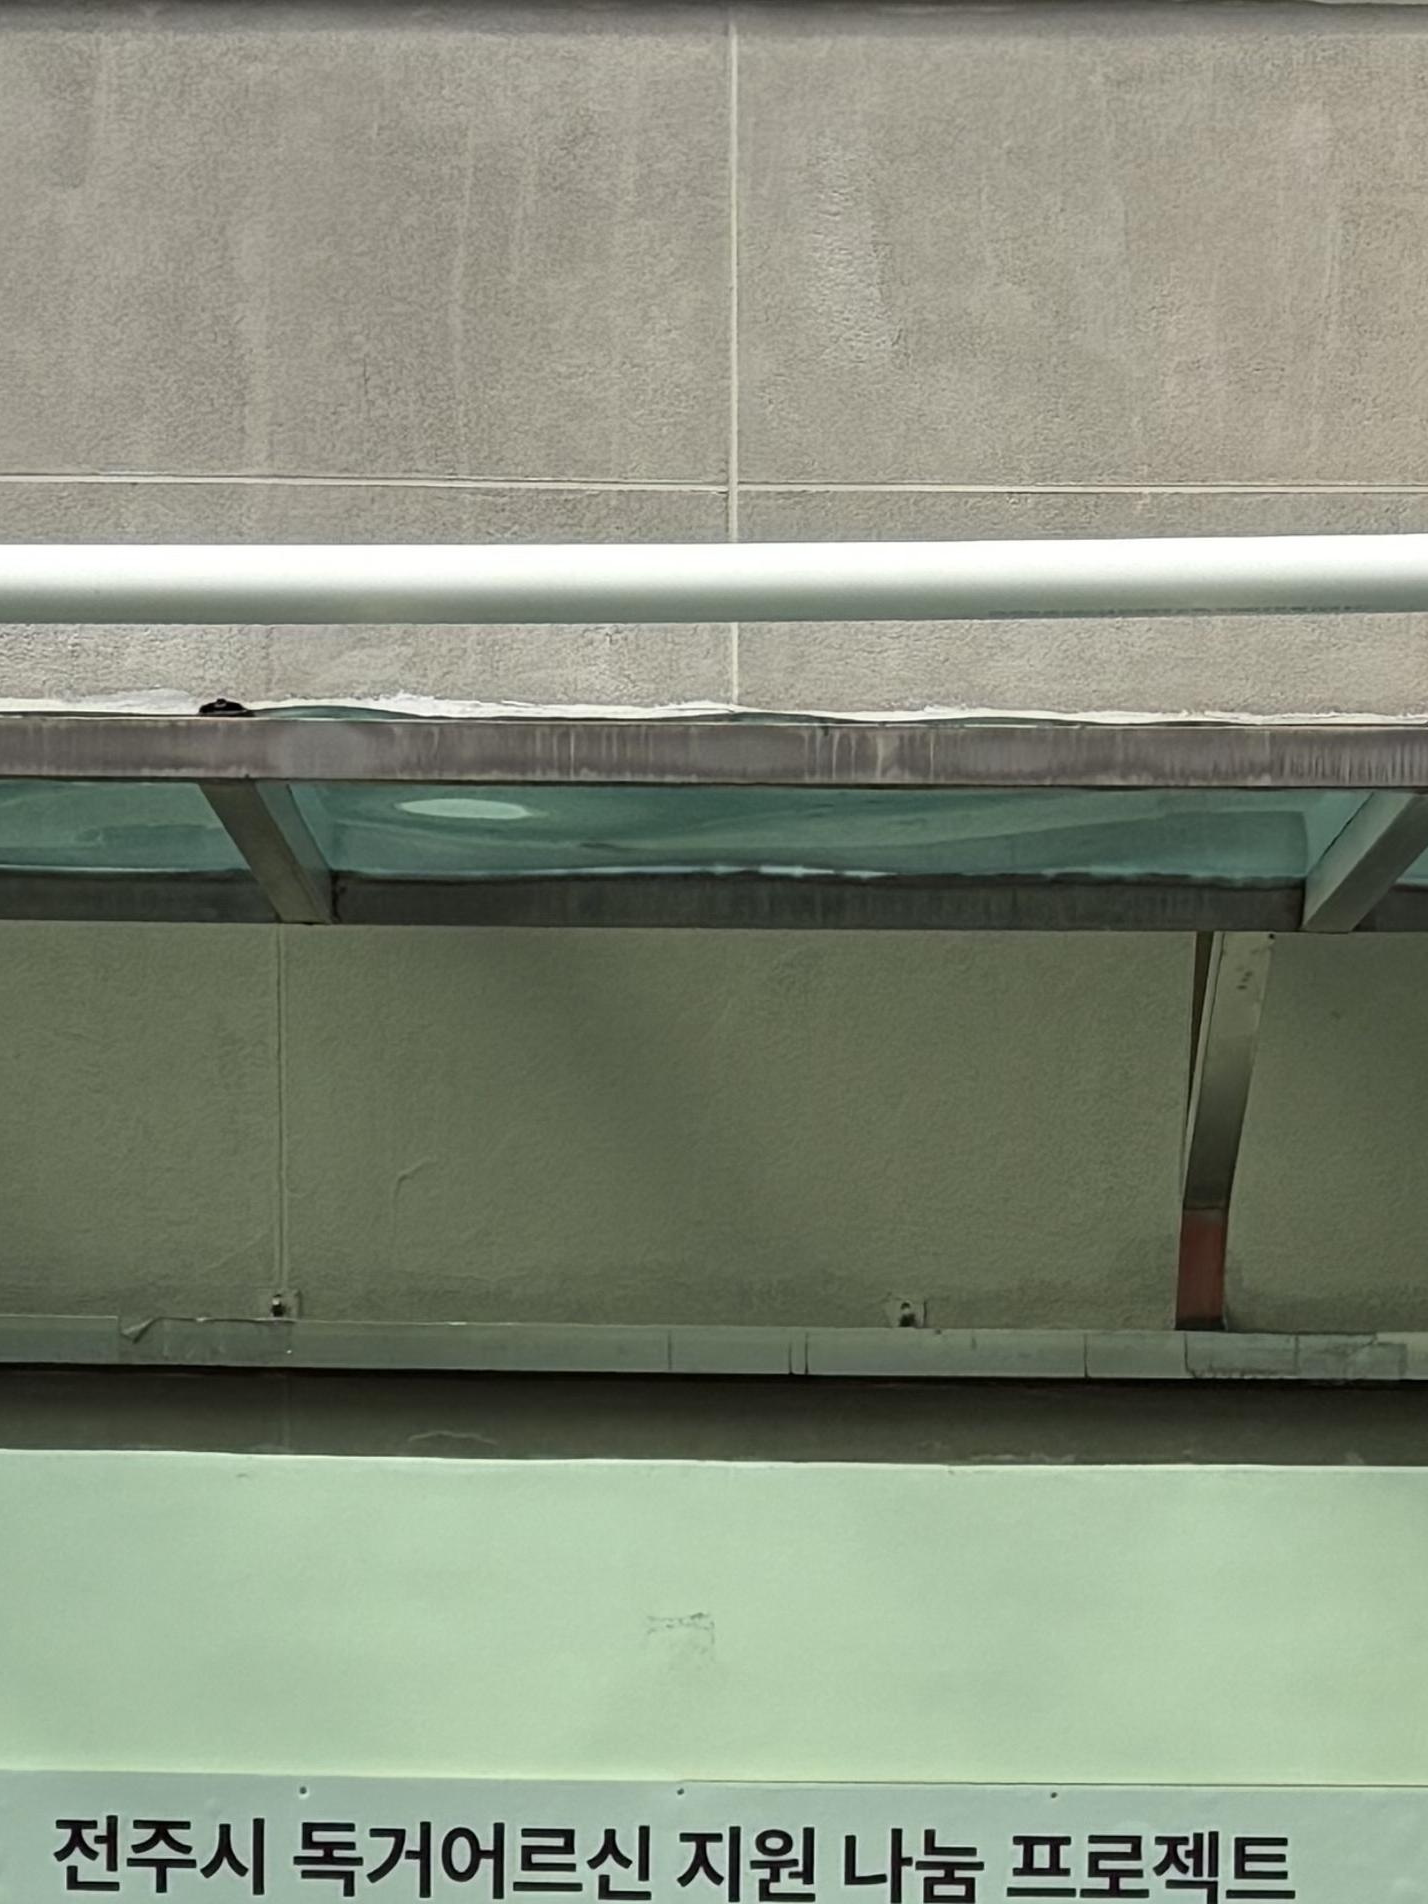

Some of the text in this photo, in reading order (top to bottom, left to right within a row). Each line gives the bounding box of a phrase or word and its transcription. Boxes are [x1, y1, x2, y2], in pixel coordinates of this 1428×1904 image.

[51, 1814, 266, 1897] 전주시
[292, 1819, 653, 1902] 독거어르신
[677, 1826, 816, 1904] 지원
